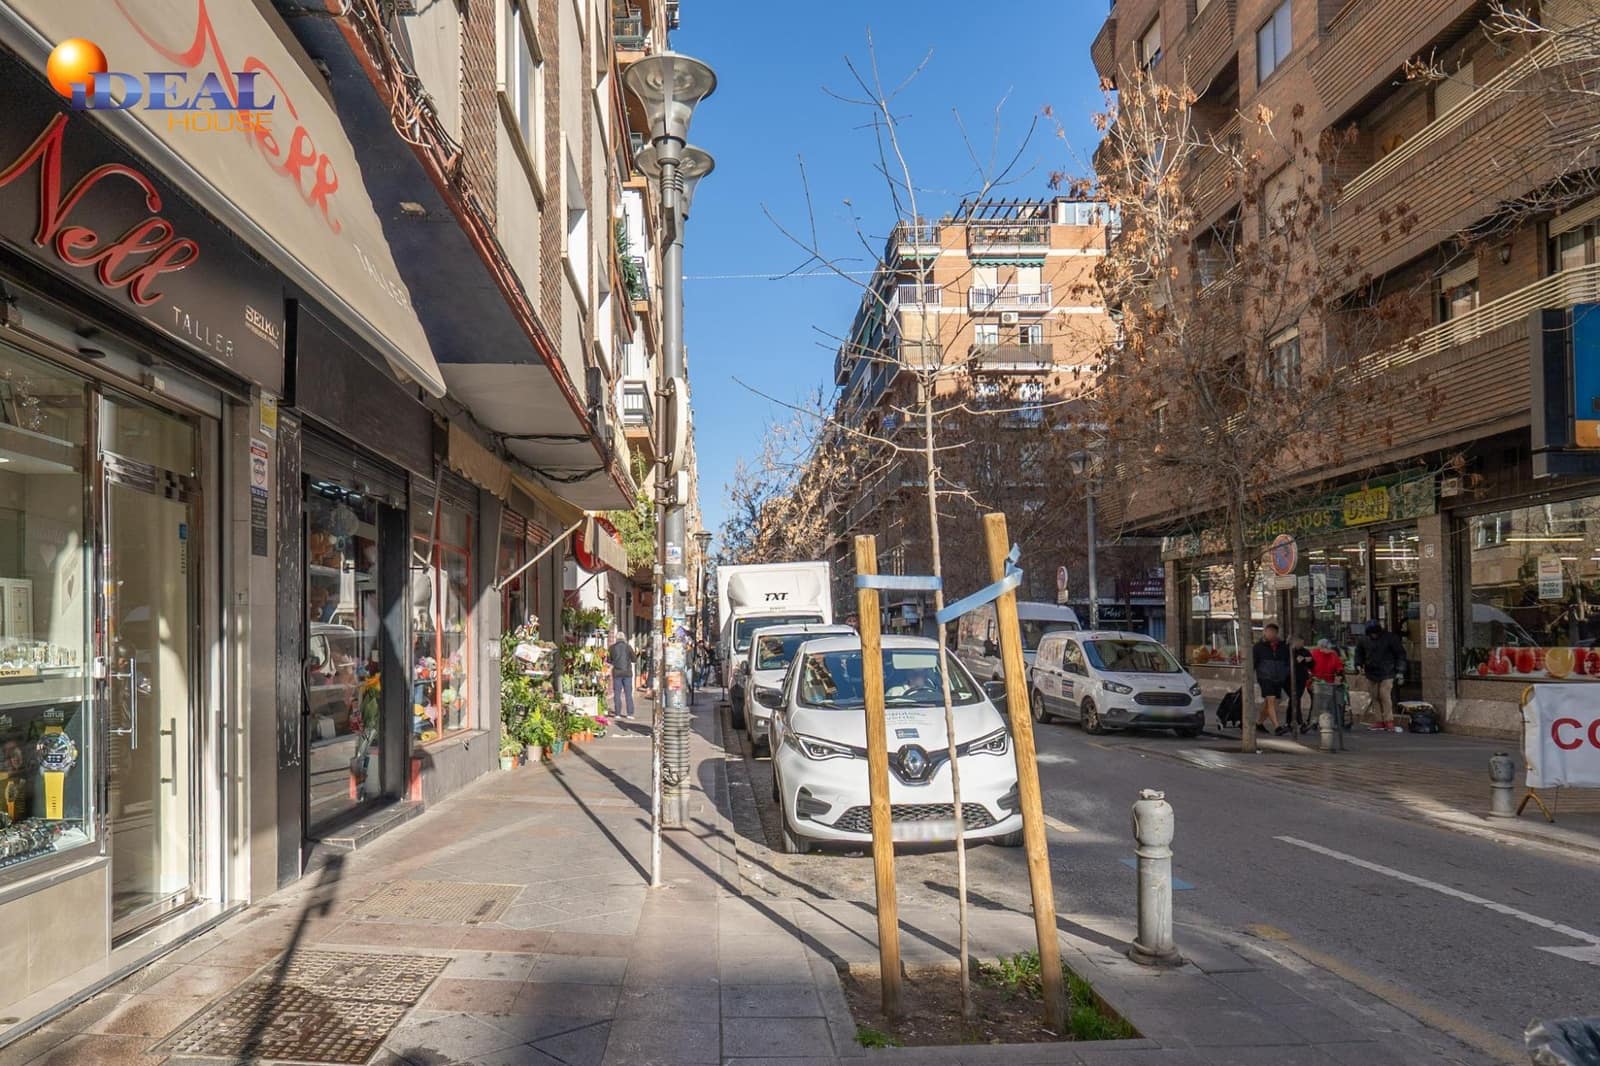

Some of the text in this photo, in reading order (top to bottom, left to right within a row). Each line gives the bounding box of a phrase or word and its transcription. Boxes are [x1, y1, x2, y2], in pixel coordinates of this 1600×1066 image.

[0, 112, 200, 306] Nell
[172, 305, 234, 358] TALLER
[244, 304, 280, 341] SEIKO
[764, 592, 789, 602] TXT
